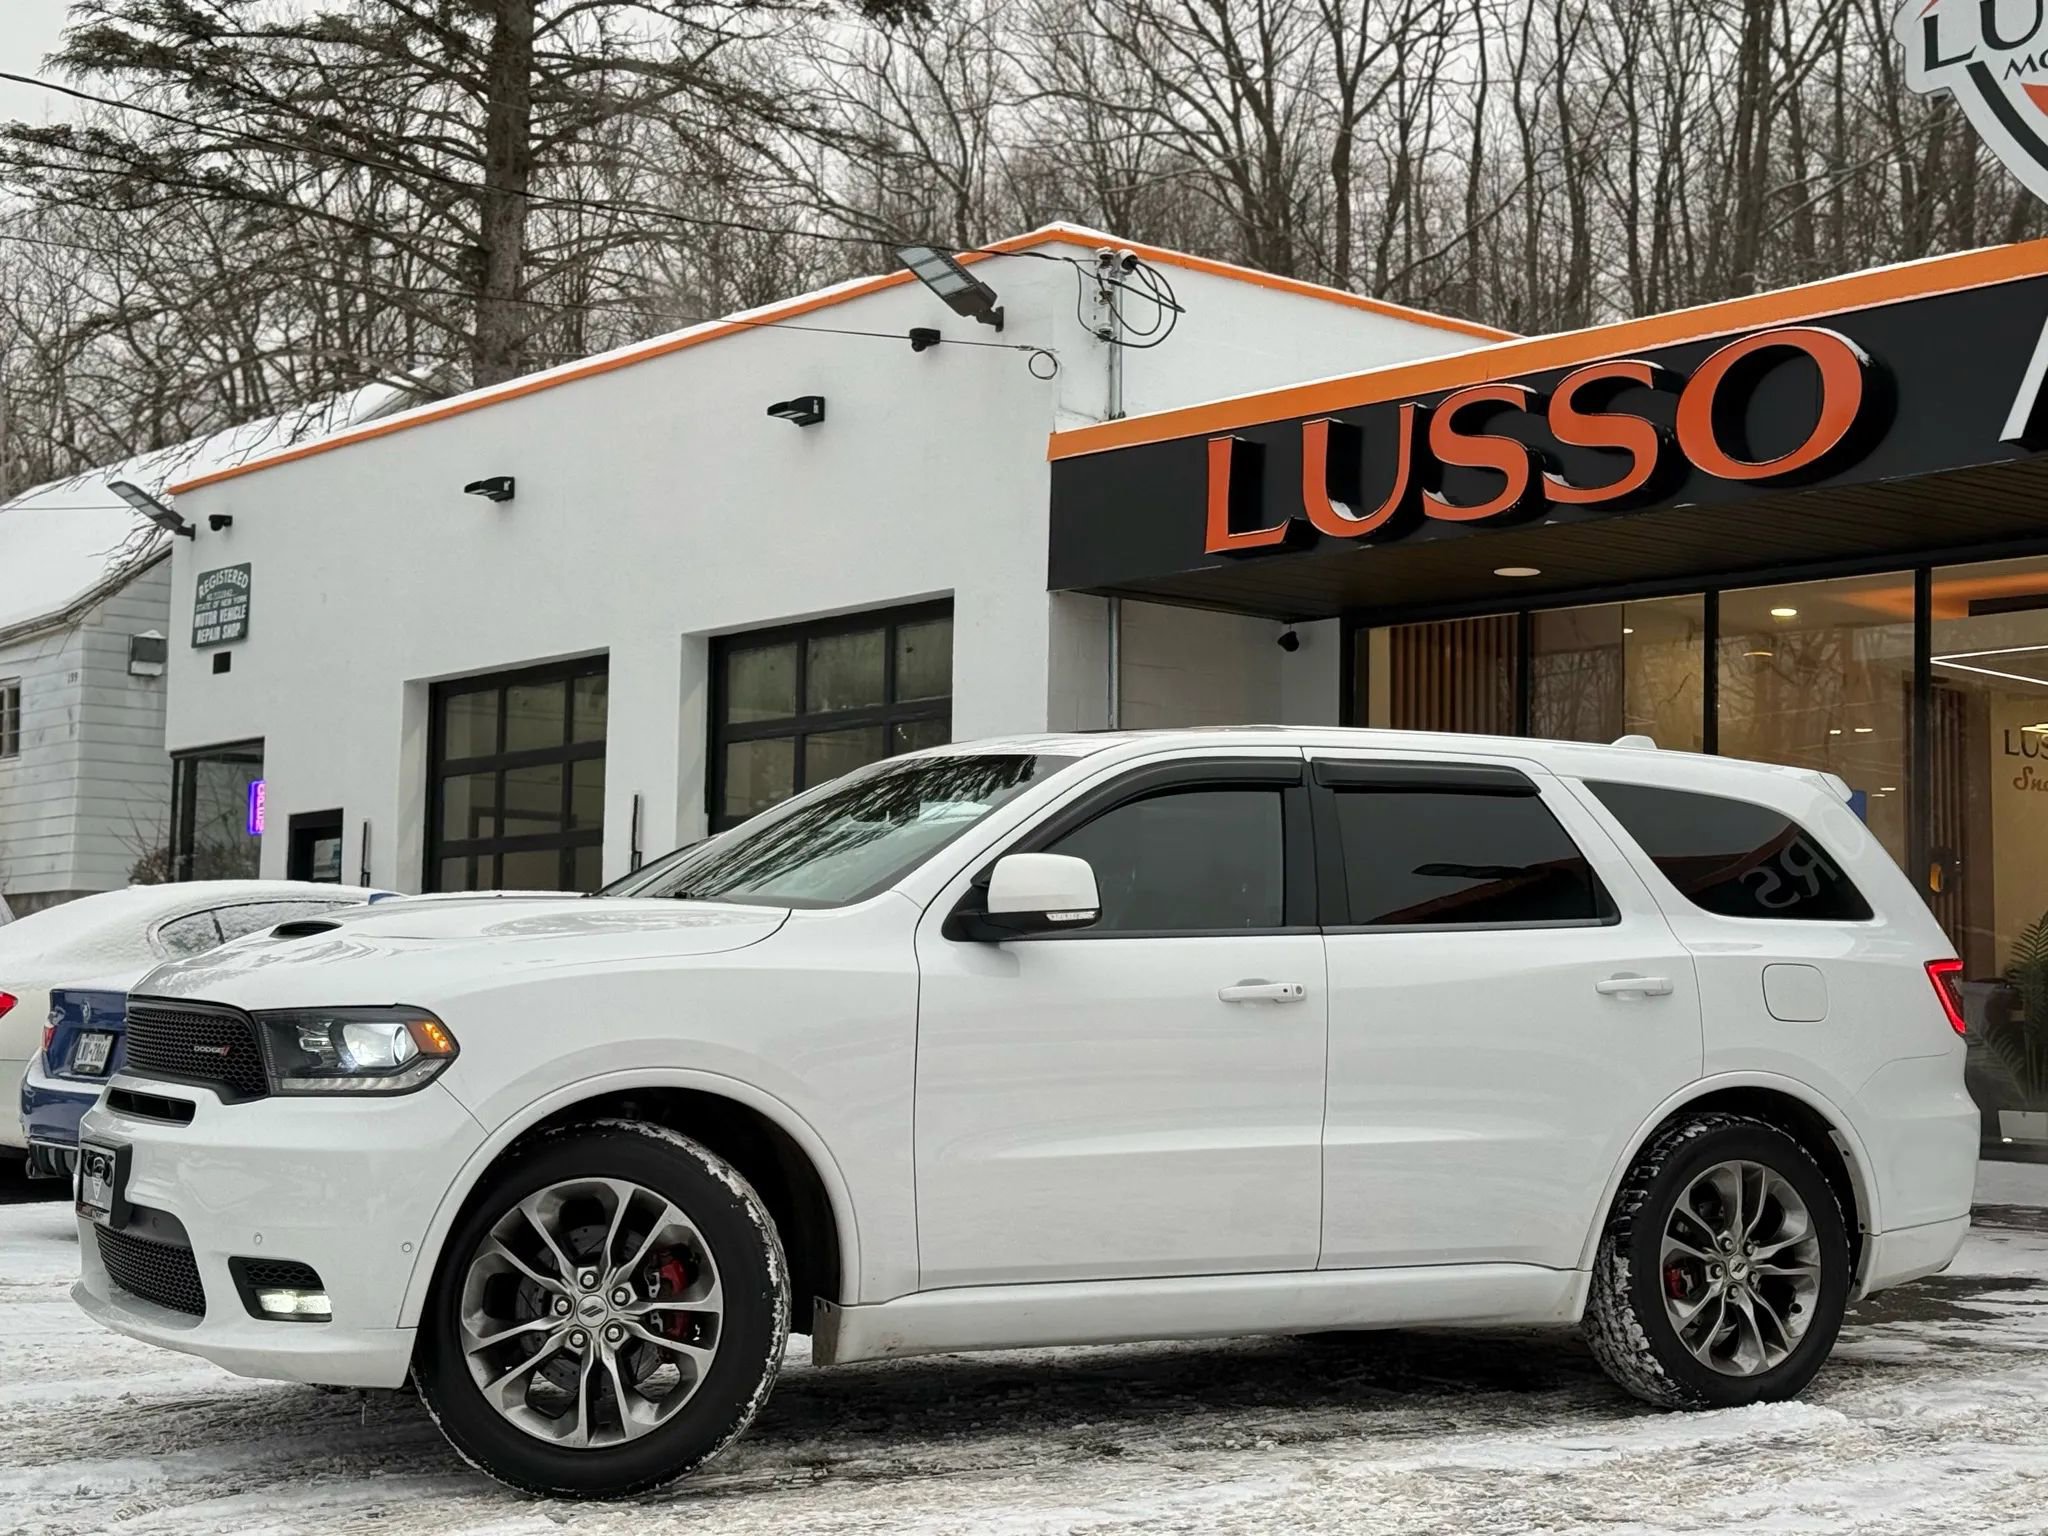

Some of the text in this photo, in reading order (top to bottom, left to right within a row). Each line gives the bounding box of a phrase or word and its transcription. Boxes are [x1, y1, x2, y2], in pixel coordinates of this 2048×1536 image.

[1205, 327, 1864, 555] LUSSO
[199, 569, 249, 599] REGISTERED
[219, 604, 247, 622] VEHICLE
[196, 622, 241, 644] REPAIR SHOP
